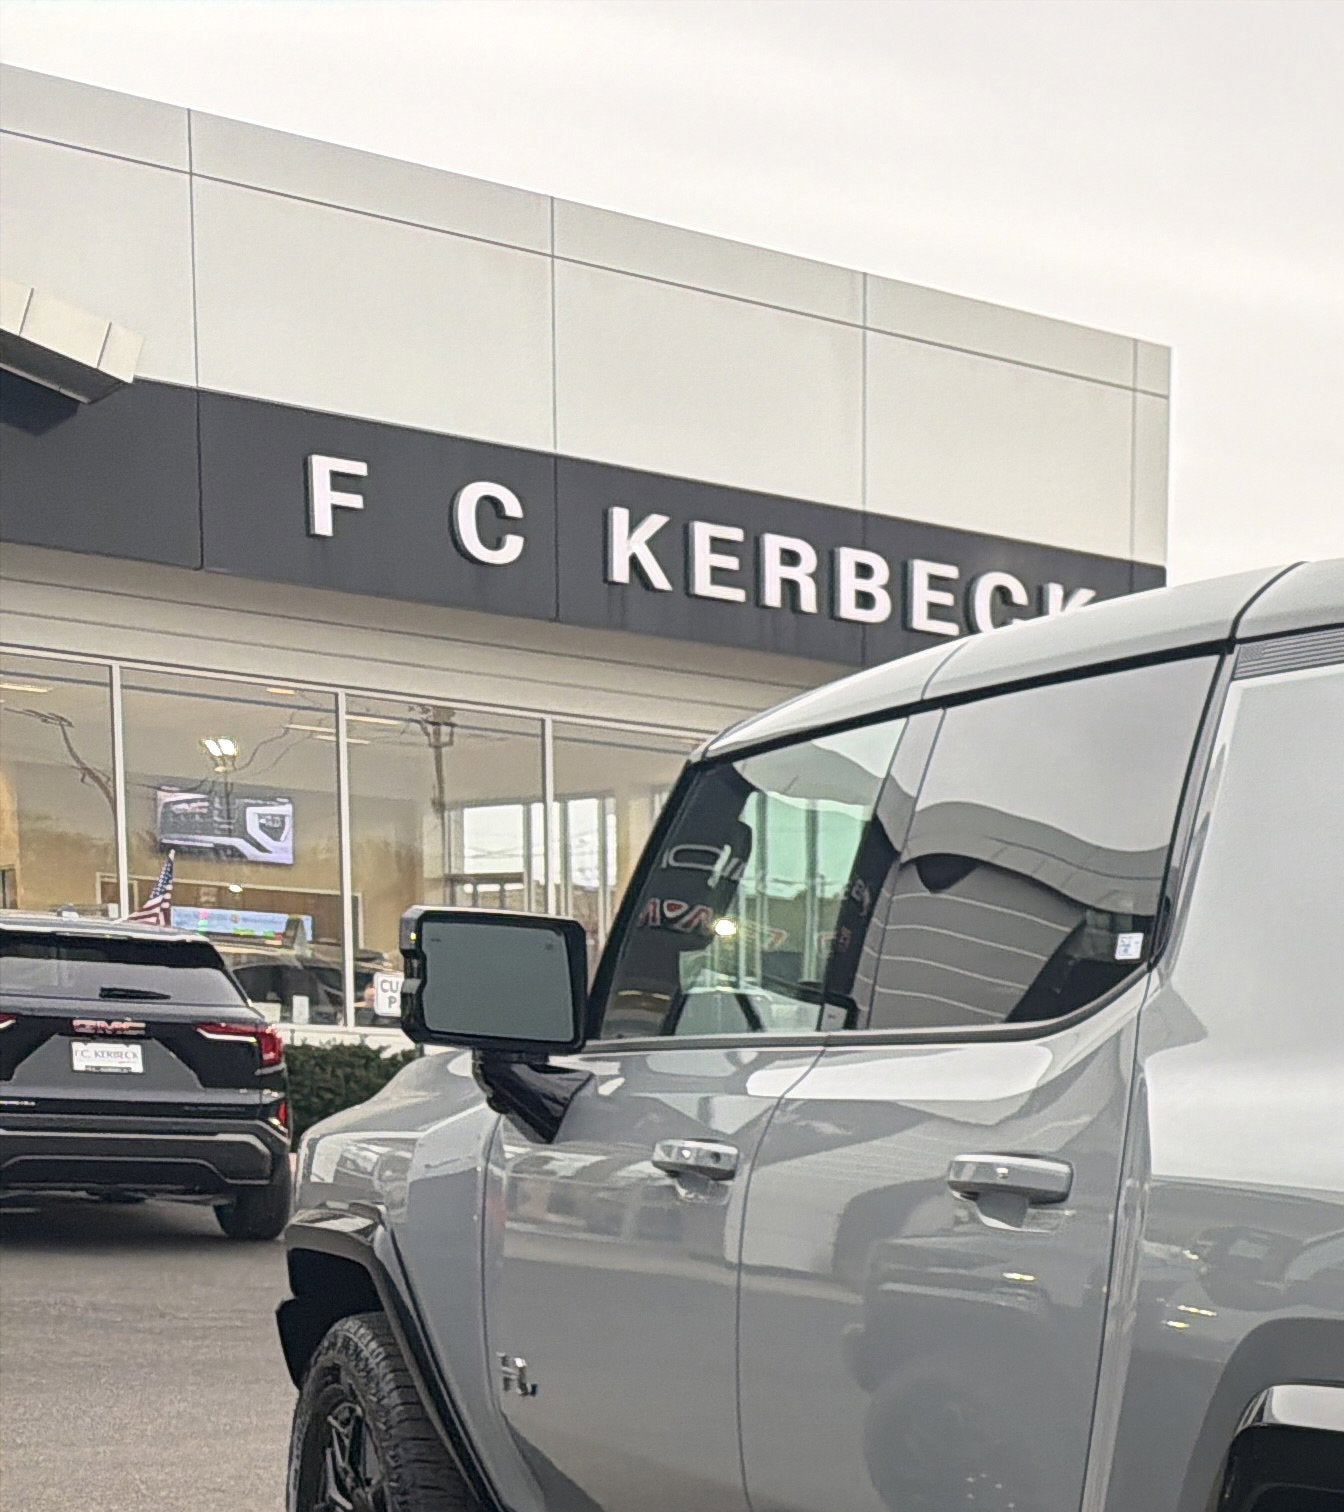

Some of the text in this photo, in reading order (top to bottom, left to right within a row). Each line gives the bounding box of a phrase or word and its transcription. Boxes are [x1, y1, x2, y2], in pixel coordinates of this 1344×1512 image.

[307, 454, 369, 538] F
[454, 480, 526, 566] C
[72, 1019, 147, 1036] GMC
